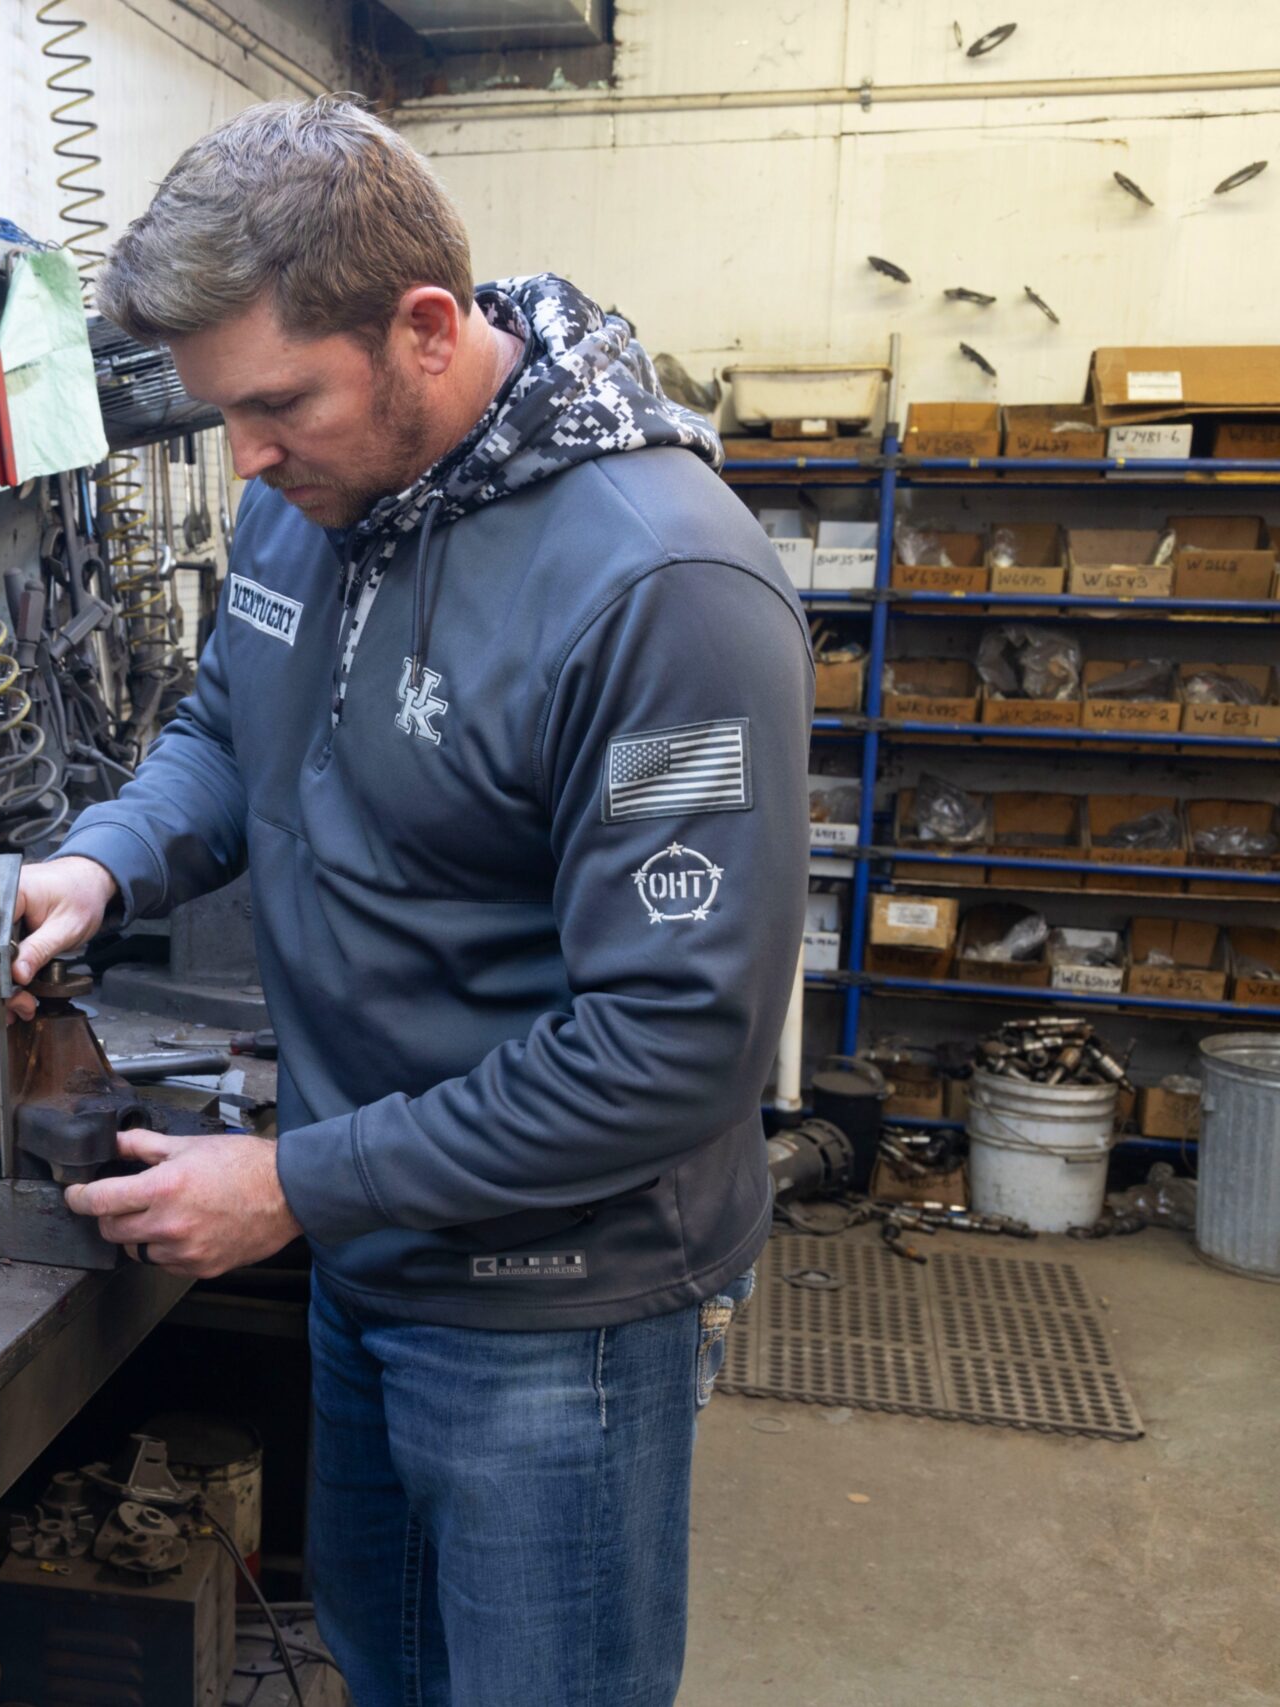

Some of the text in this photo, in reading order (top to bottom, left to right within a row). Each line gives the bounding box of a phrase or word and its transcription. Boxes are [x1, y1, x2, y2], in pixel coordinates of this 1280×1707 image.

[231, 583, 297, 635] KENTUCKY
[395, 657, 449, 745] UK
[648, 870, 706, 900] OHT
[498, 1265, 582, 1276] COLOSSEUM ATHLETICS
